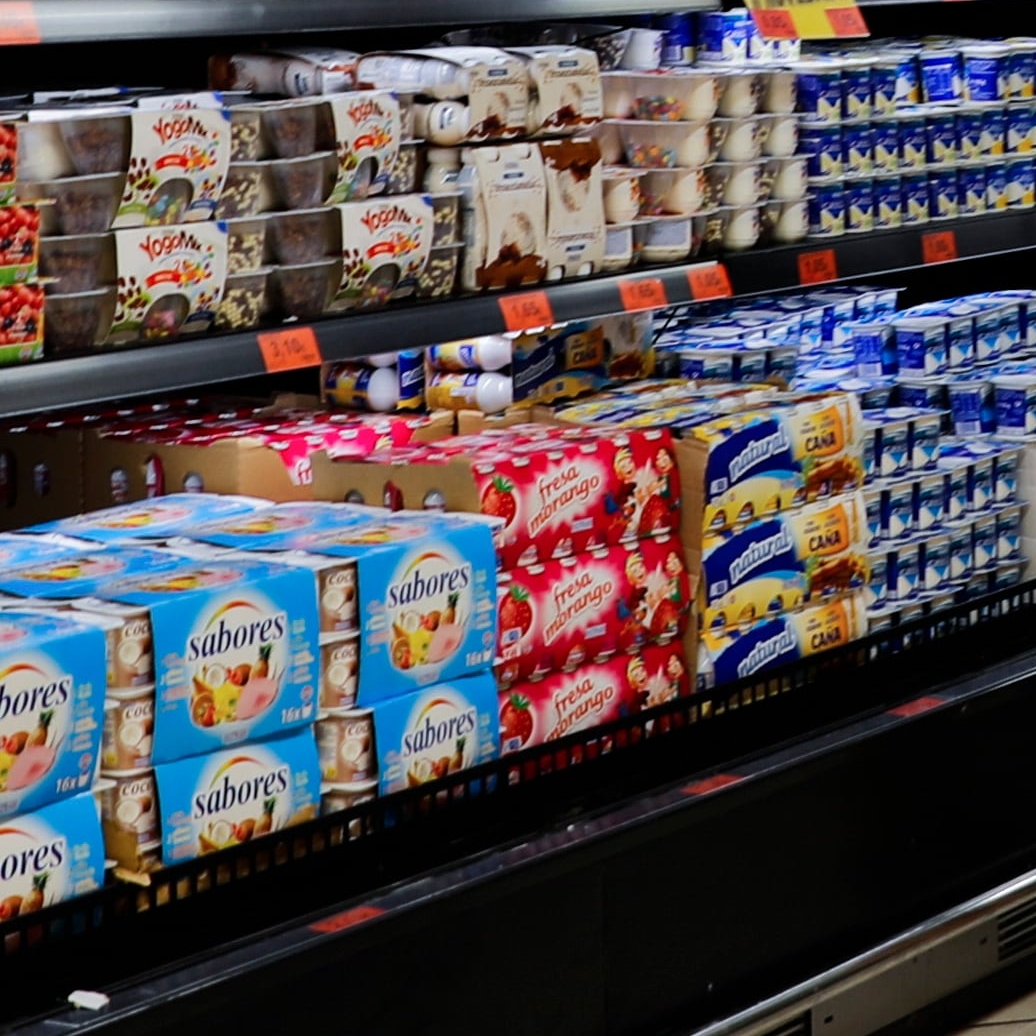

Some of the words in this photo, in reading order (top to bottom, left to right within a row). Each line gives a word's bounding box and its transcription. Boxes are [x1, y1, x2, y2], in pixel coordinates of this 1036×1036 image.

[729, 424, 790, 483] natural
[805, 430, 837, 452] CAÑA
[530, 475, 601, 534] morango
[538, 465, 580, 502] fresa
[729, 524, 793, 582] natural
[809, 529, 842, 552] CAÑA
[388, 566, 470, 609] sabores
[553, 572, 593, 609] fresa
[545, 582, 614, 641] morango
[188, 614, 285, 662] sabores
[811, 627, 842, 650] CAÑA
[555, 678, 594, 715] fresa
[403, 710, 475, 758] sabores
[194, 768, 288, 820] sabores
